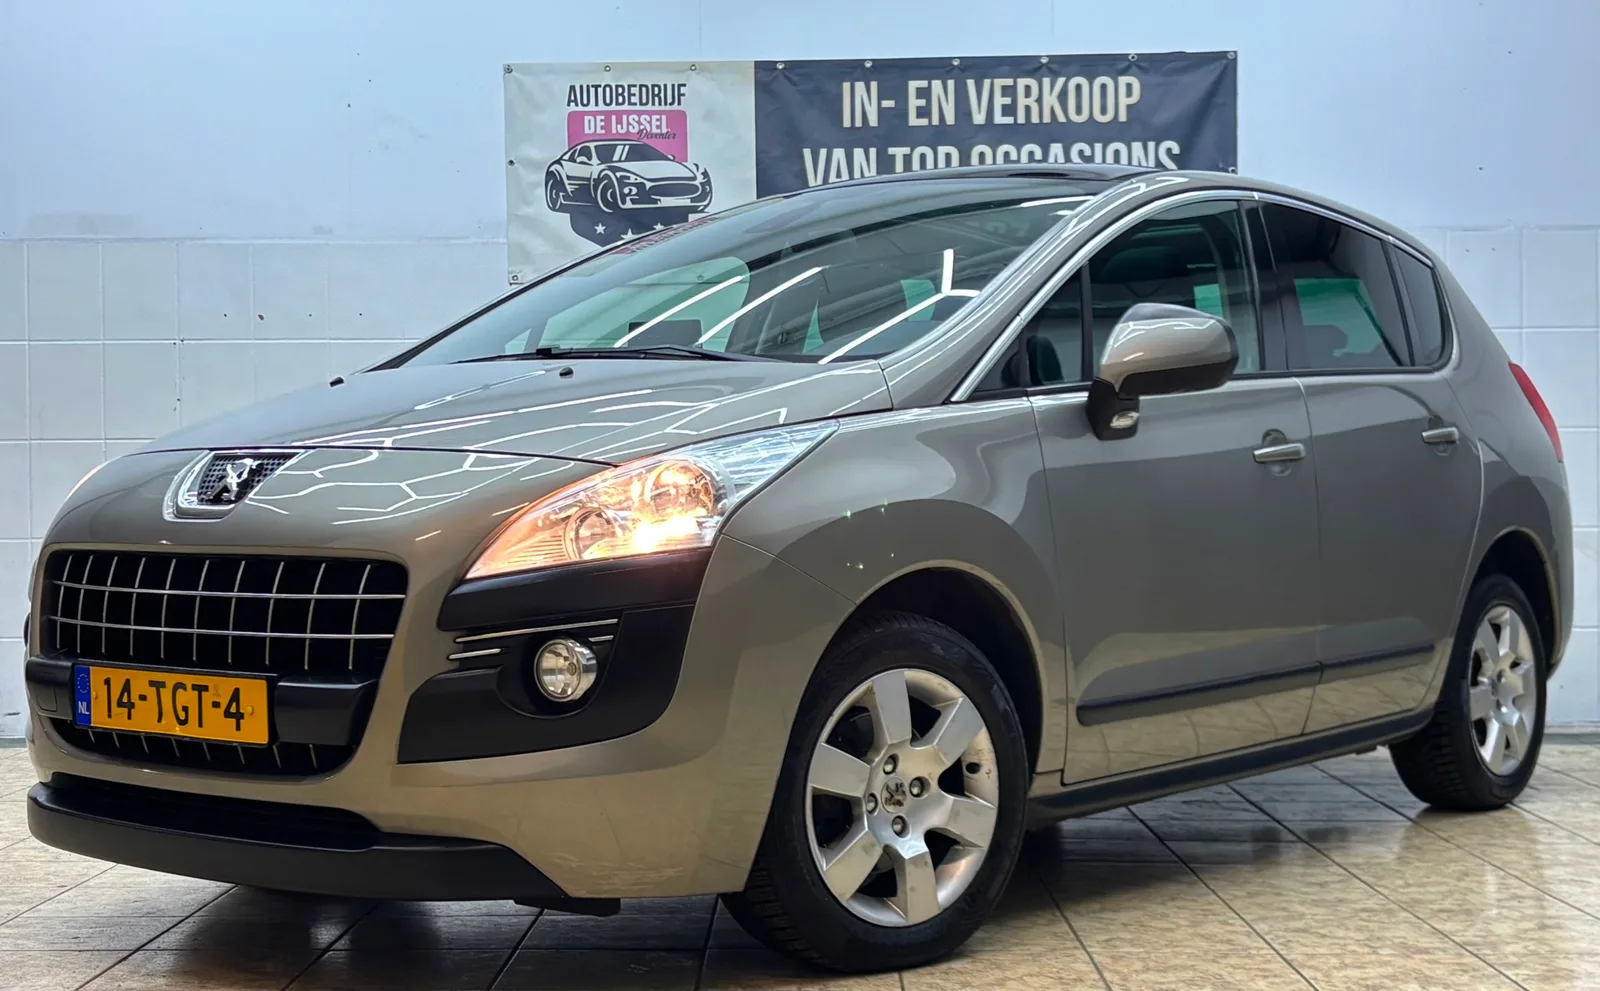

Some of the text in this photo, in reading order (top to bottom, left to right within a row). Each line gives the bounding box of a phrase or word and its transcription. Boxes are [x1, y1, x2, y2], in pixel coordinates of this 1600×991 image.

[566, 83, 687, 108] AUTOBEDRIJF
[842, 75, 1141, 128] IN- EN VERKOOP
[584, 114, 671, 134] DE IJSSEL
[636, 128, 677, 140] Deventer
[802, 147, 878, 188] VAN
[78, 700, 90, 715] NL
[103, 676, 245, 732] 14-TGT-4
